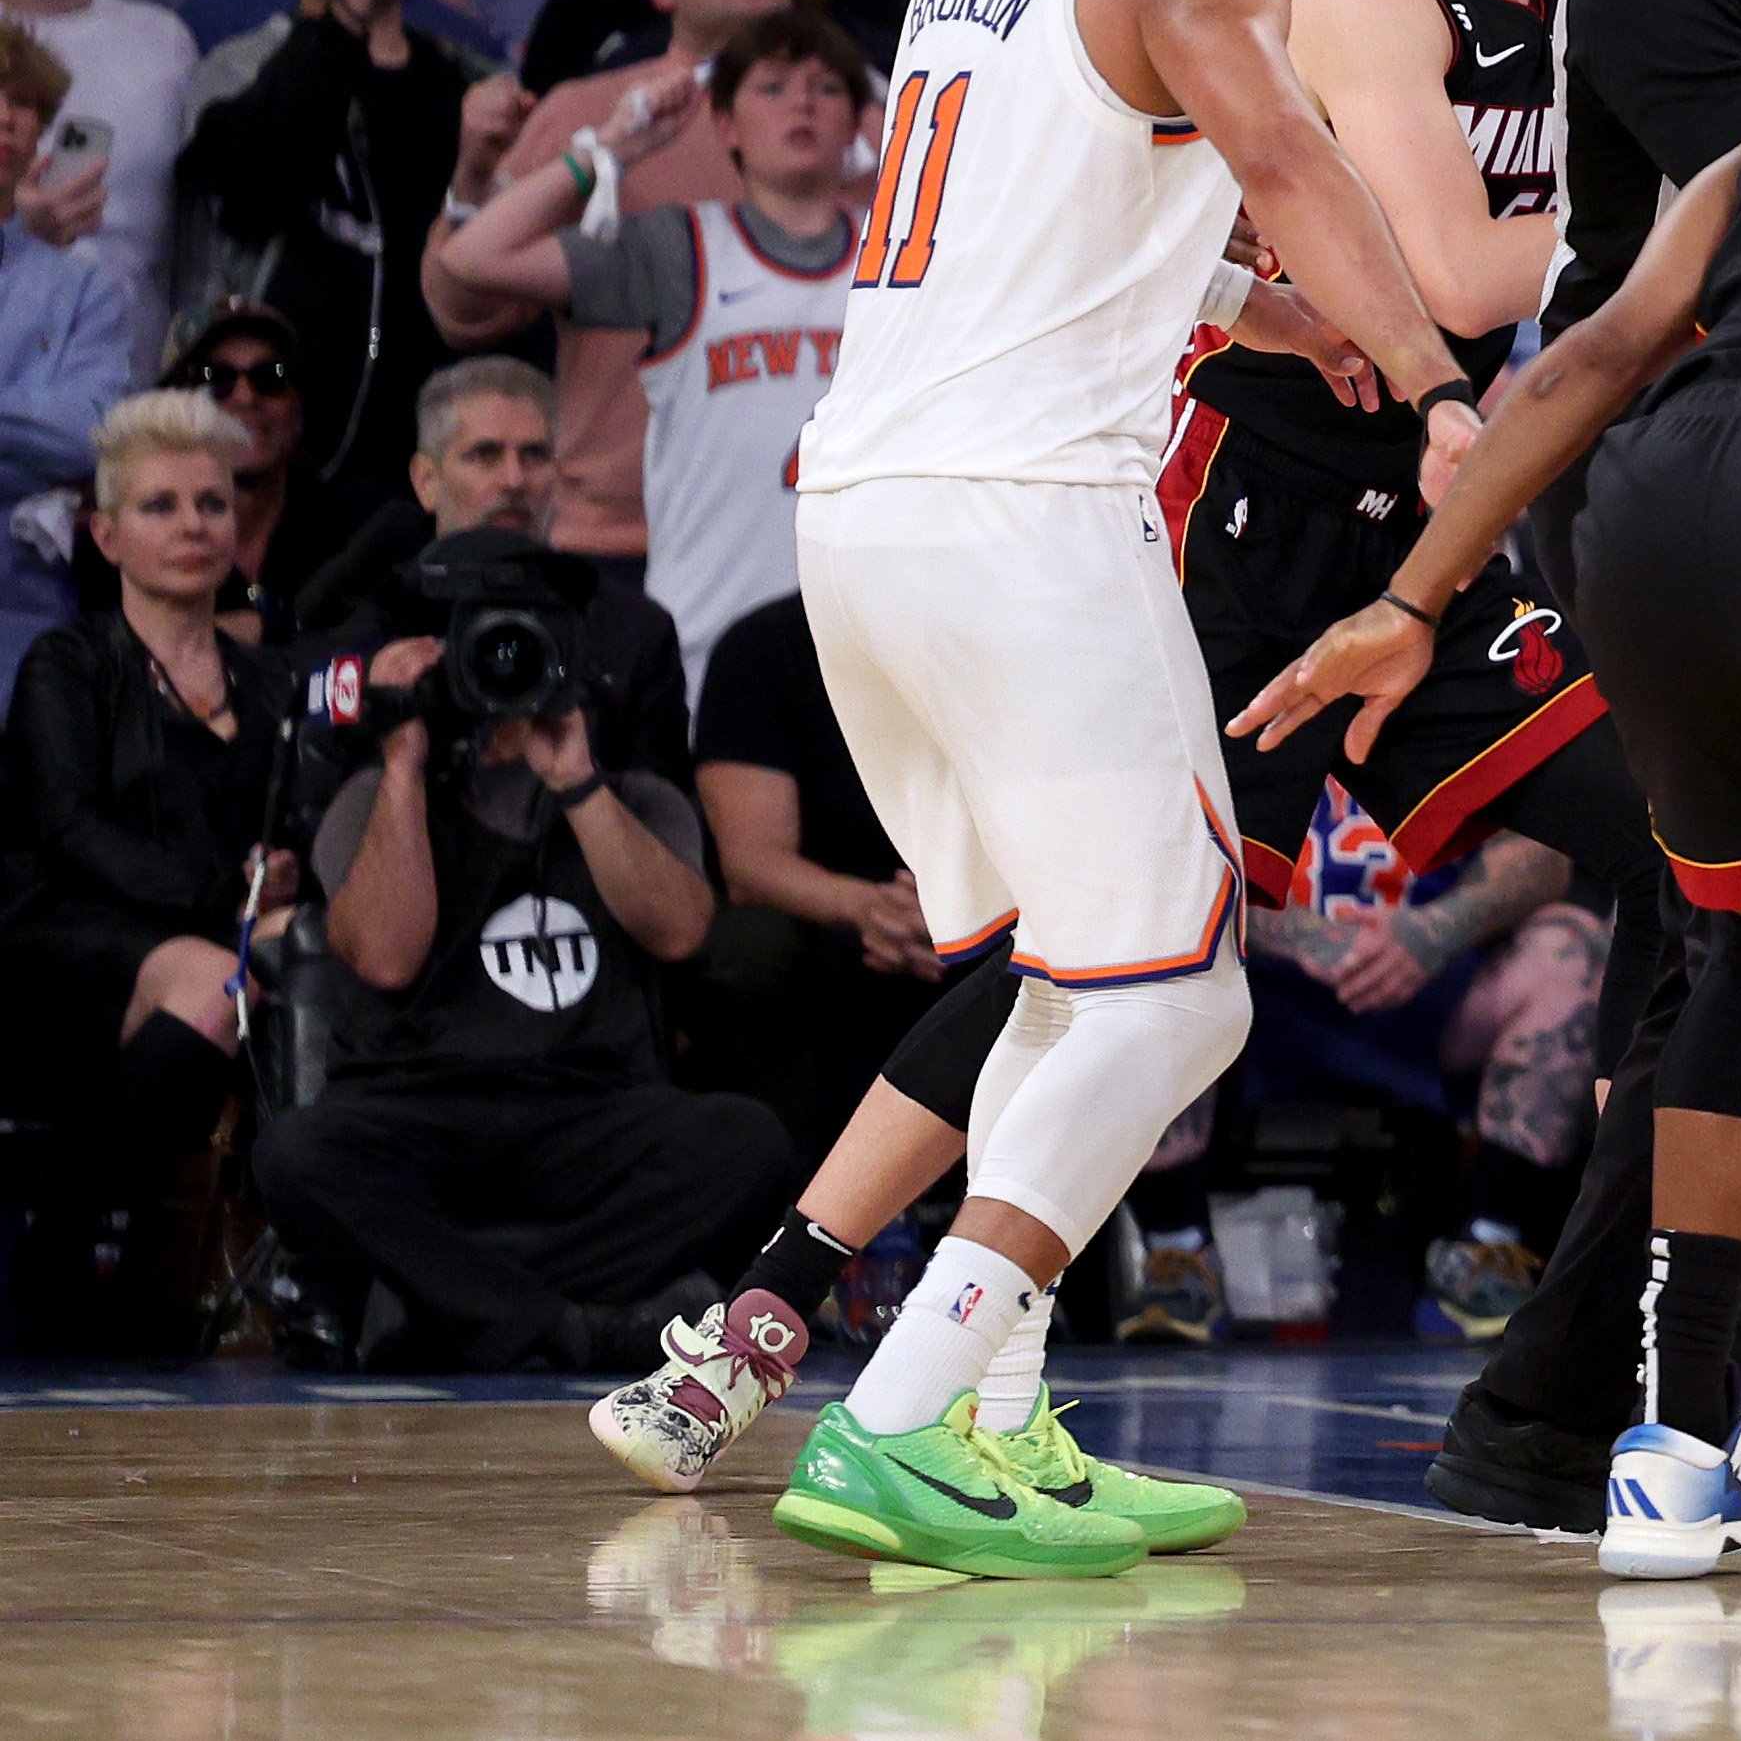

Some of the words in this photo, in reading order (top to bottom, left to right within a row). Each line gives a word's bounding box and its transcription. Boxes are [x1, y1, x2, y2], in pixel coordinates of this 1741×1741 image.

[851, 70, 972, 289] 11
[706, 330, 801, 392] NEW
[481, 931, 594, 975] TNT
